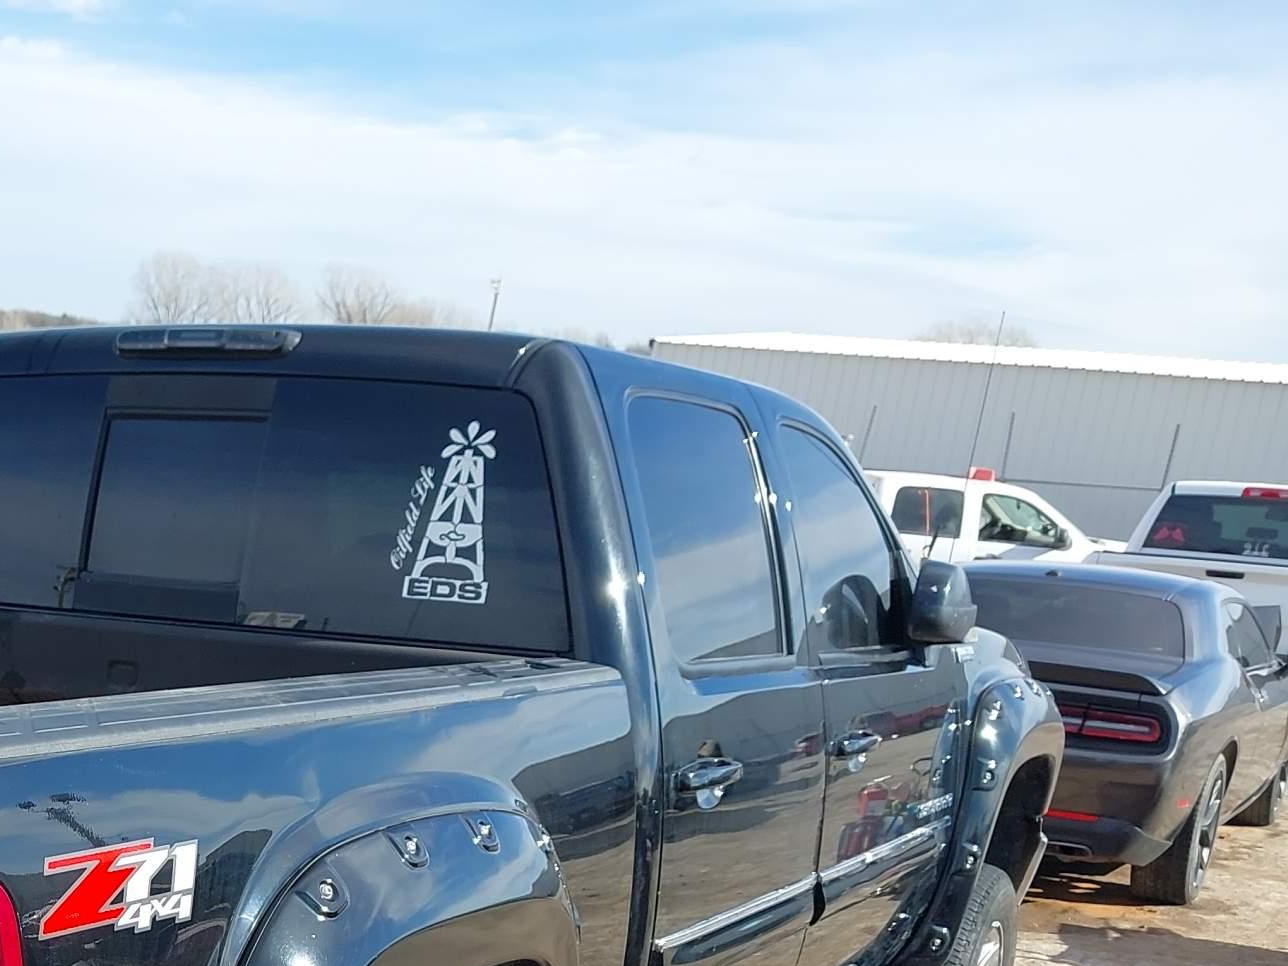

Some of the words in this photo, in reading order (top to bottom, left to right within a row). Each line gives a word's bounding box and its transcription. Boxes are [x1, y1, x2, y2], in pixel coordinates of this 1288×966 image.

[390, 503, 421, 570] Oilfield
[411, 465, 436, 506] Life
[406, 578, 482, 600] EDS
[38, 837, 199, 941] Z71
